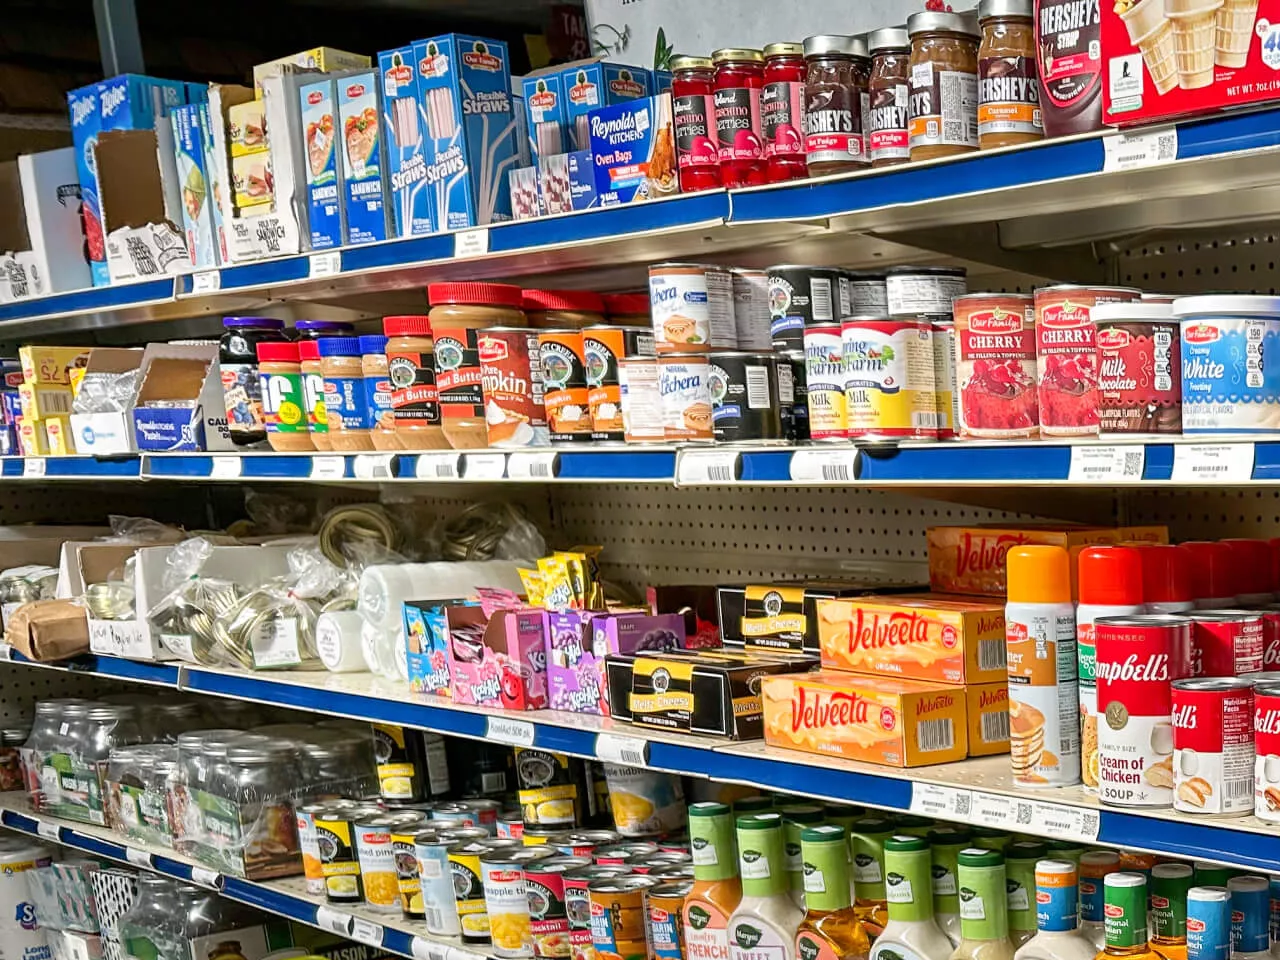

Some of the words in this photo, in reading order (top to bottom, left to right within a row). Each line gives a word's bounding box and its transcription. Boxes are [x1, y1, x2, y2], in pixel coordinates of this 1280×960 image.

[1057, 31, 1080, 49] SYRUP
[982, 77, 1038, 102] ERSHEY'S
[463, 98, 510, 113] Straws
[591, 111, 636, 137] Reynolds
[609, 131, 644, 144] KITCHENS
[969, 336, 1023, 348] CHERRY
[1042, 330, 1093, 343] CHERRY
[1100, 358, 1126, 376] Milk
[1184, 360, 1224, 379] White
[849, 608, 929, 655] Velveeta
[1096, 654, 1169, 684] ampbell's
[791, 687, 868, 733] Velveeta
[1101, 769, 1140, 784] Chicken
[1105, 787, 1133, 800] SOUP
